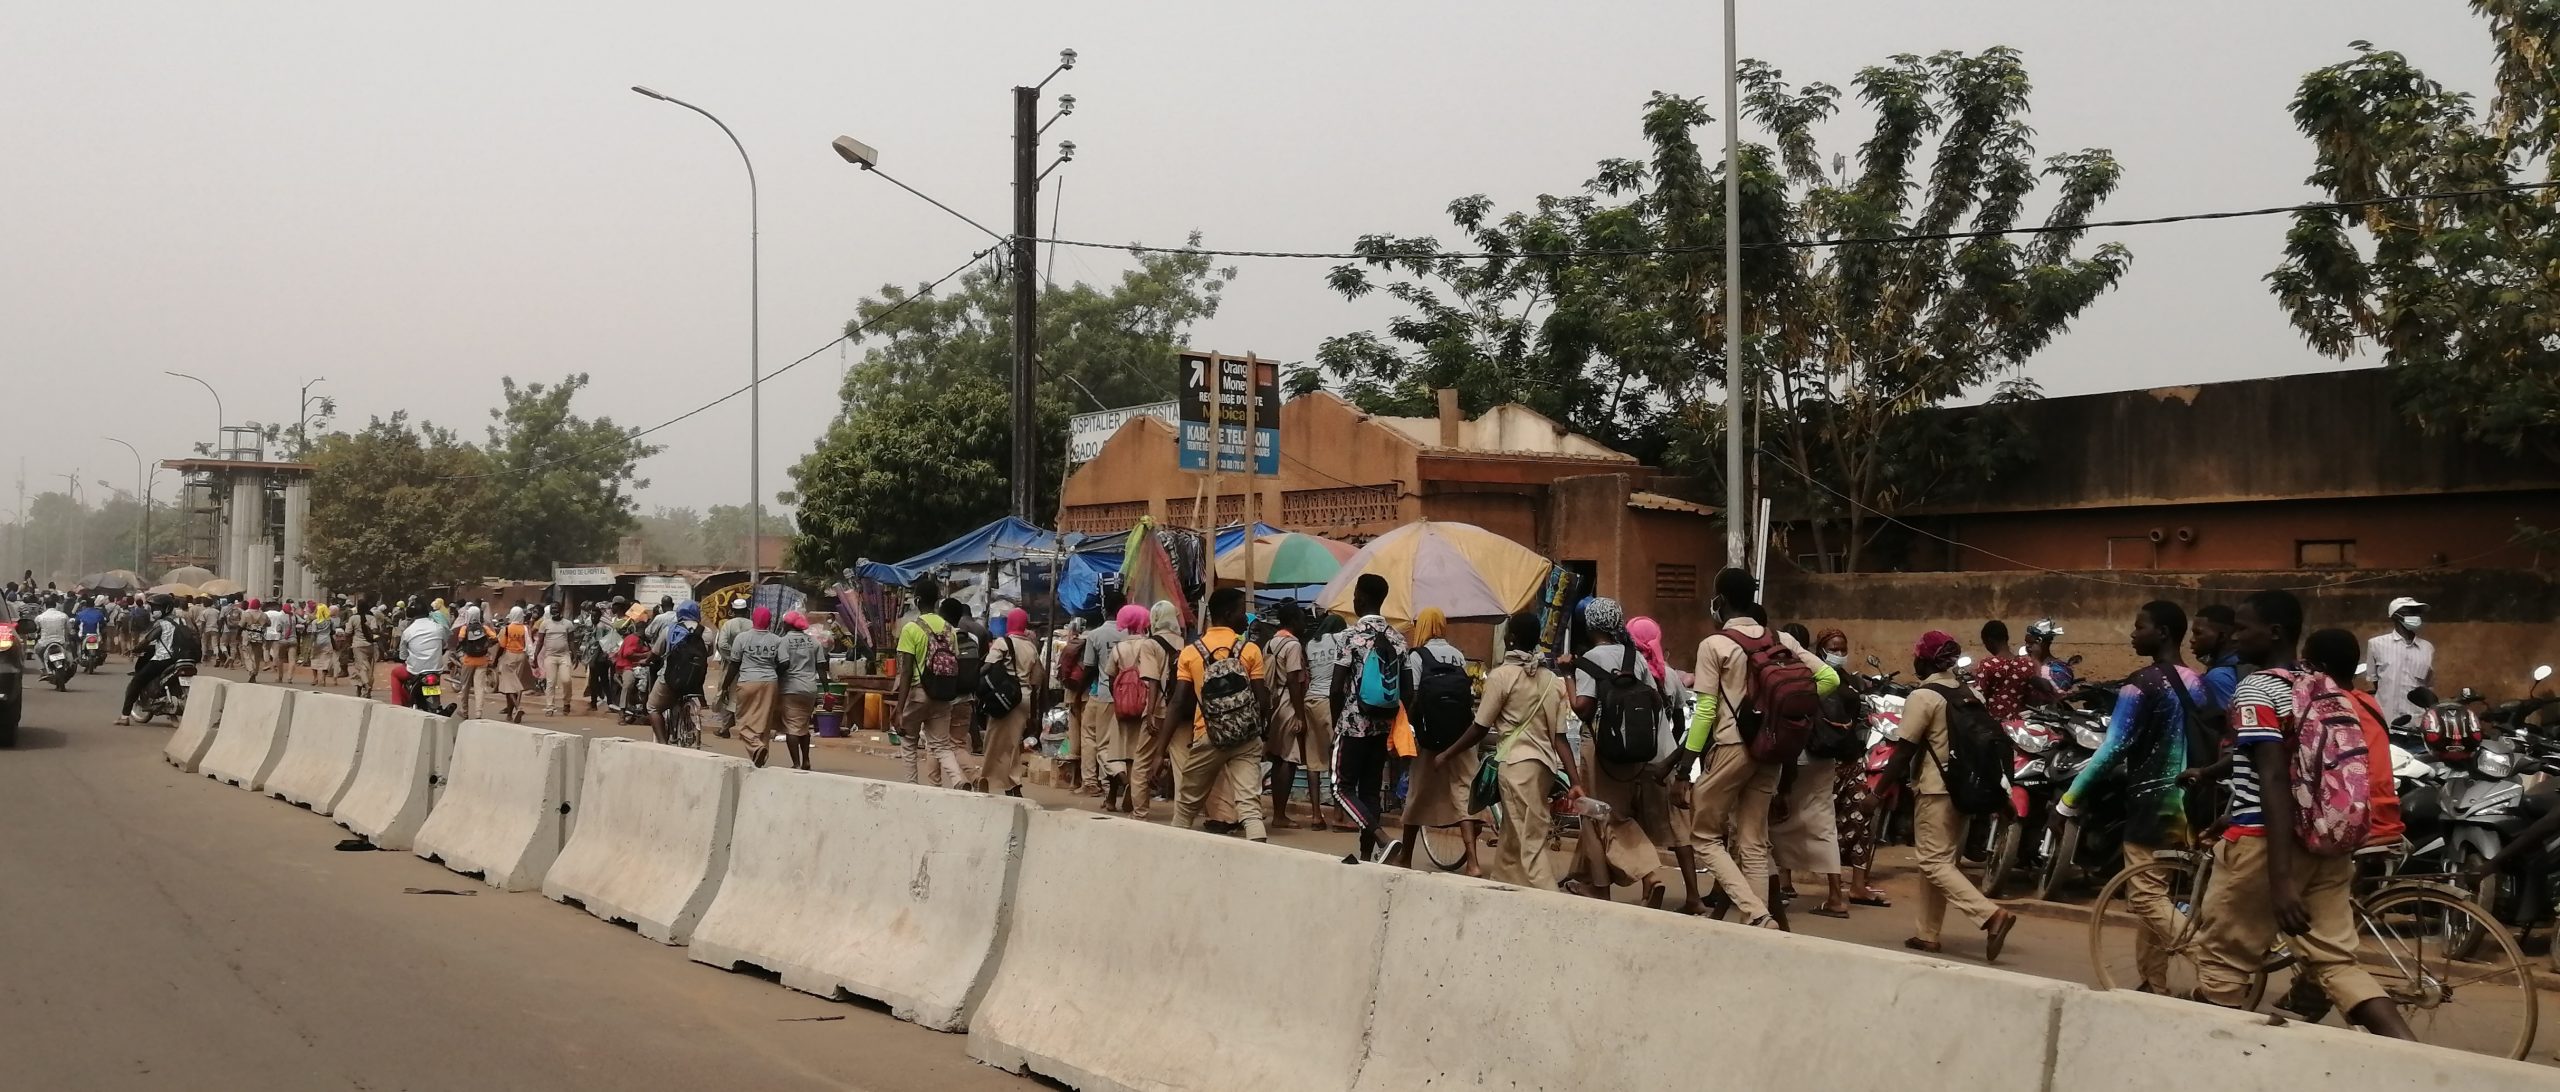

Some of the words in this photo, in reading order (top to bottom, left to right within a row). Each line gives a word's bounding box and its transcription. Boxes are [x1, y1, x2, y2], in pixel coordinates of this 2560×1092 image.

[1223, 361, 1248, 378] Orang
[1198, 391, 1236, 405] RECARGE
[1236, 394, 1264, 407] D'UTE
[1202, 404, 1260, 421] Mbicah
[1071, 413, 1121, 434] OSPITALIER
[1187, 425, 1224, 443] KABOE
[1226, 429, 1270, 447] TELEOM
[1073, 441, 1098, 460] GADO
